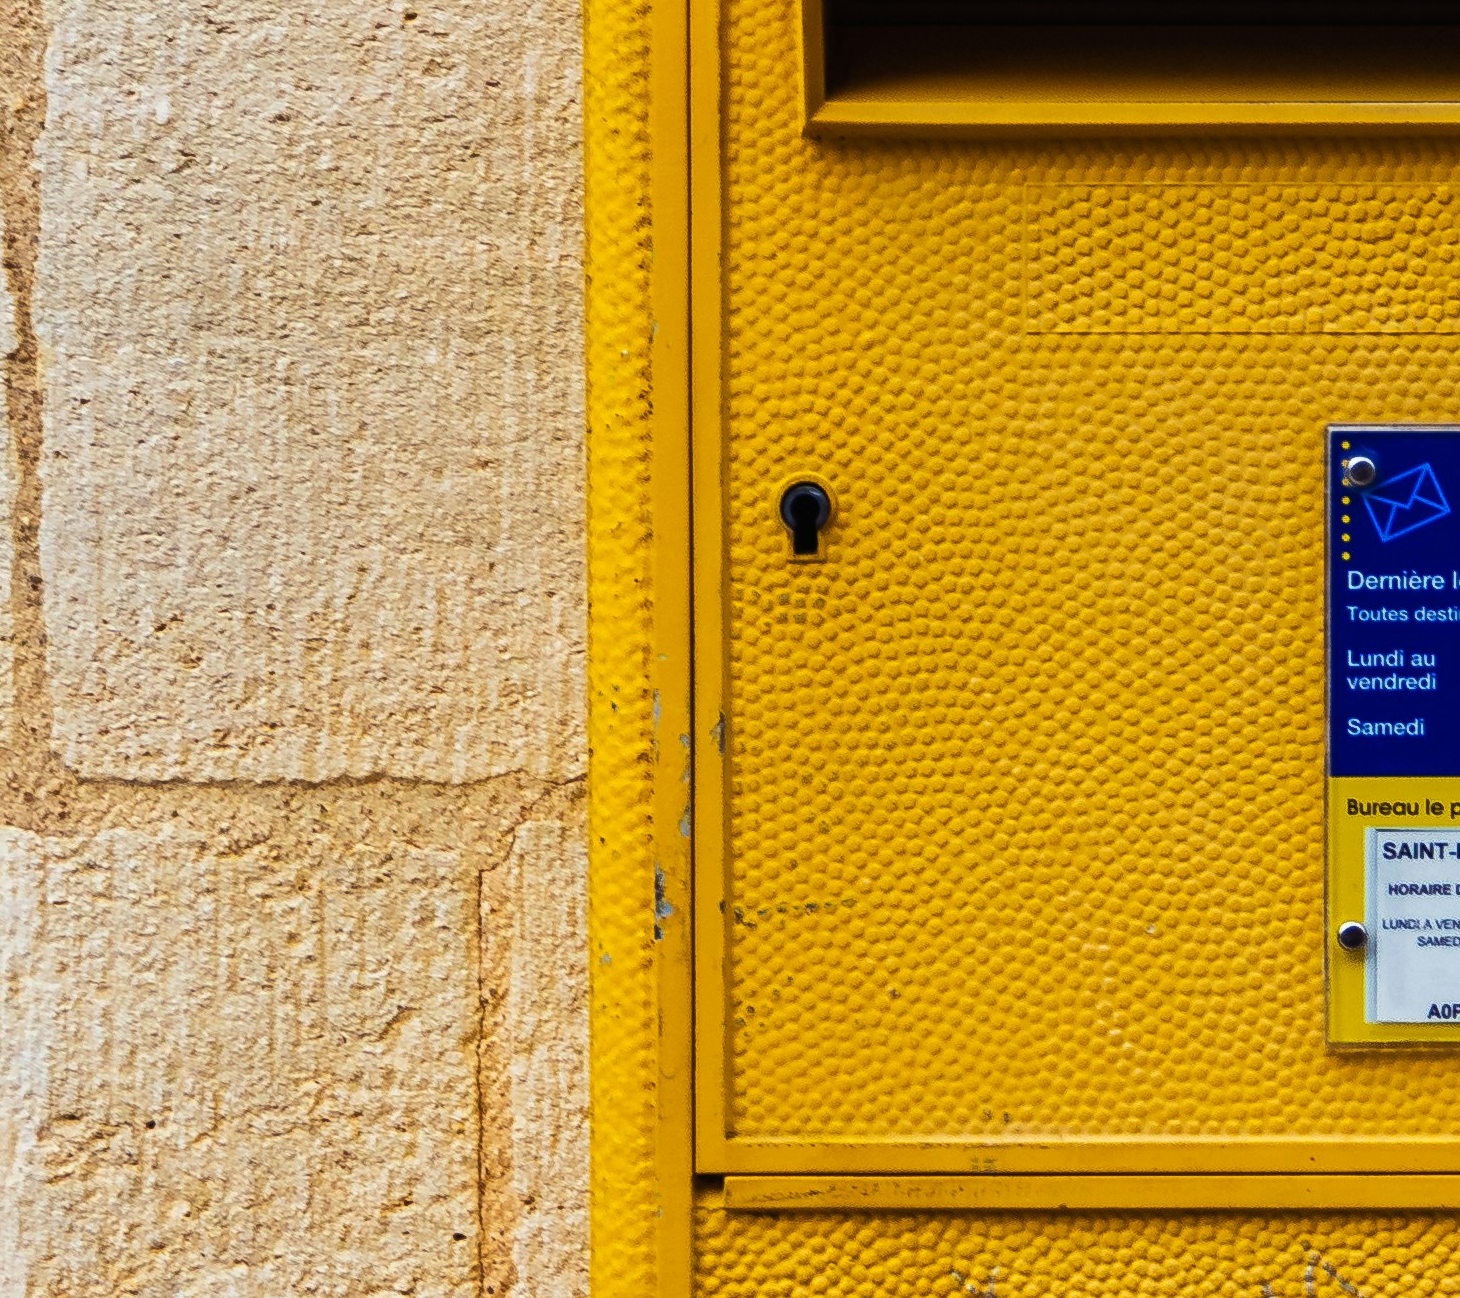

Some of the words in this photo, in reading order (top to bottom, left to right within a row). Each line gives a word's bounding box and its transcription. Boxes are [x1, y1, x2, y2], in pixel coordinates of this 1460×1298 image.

[1348, 571, 1445, 589] Dernière
[1347, 606, 1409, 621] Toutes
[1348, 650, 1403, 666] Lundi
[1411, 654, 1435, 666] au
[1347, 673, 1436, 689] vendredi
[1348, 719, 1424, 735] Samedi
[1347, 798, 1419, 816] Bureau
[1426, 798, 1444, 815] le
[1389, 884, 1451, 895] HORAIRE
[1383, 919, 1420, 930] LUNDI
[1423, 919, 1433, 930] A
